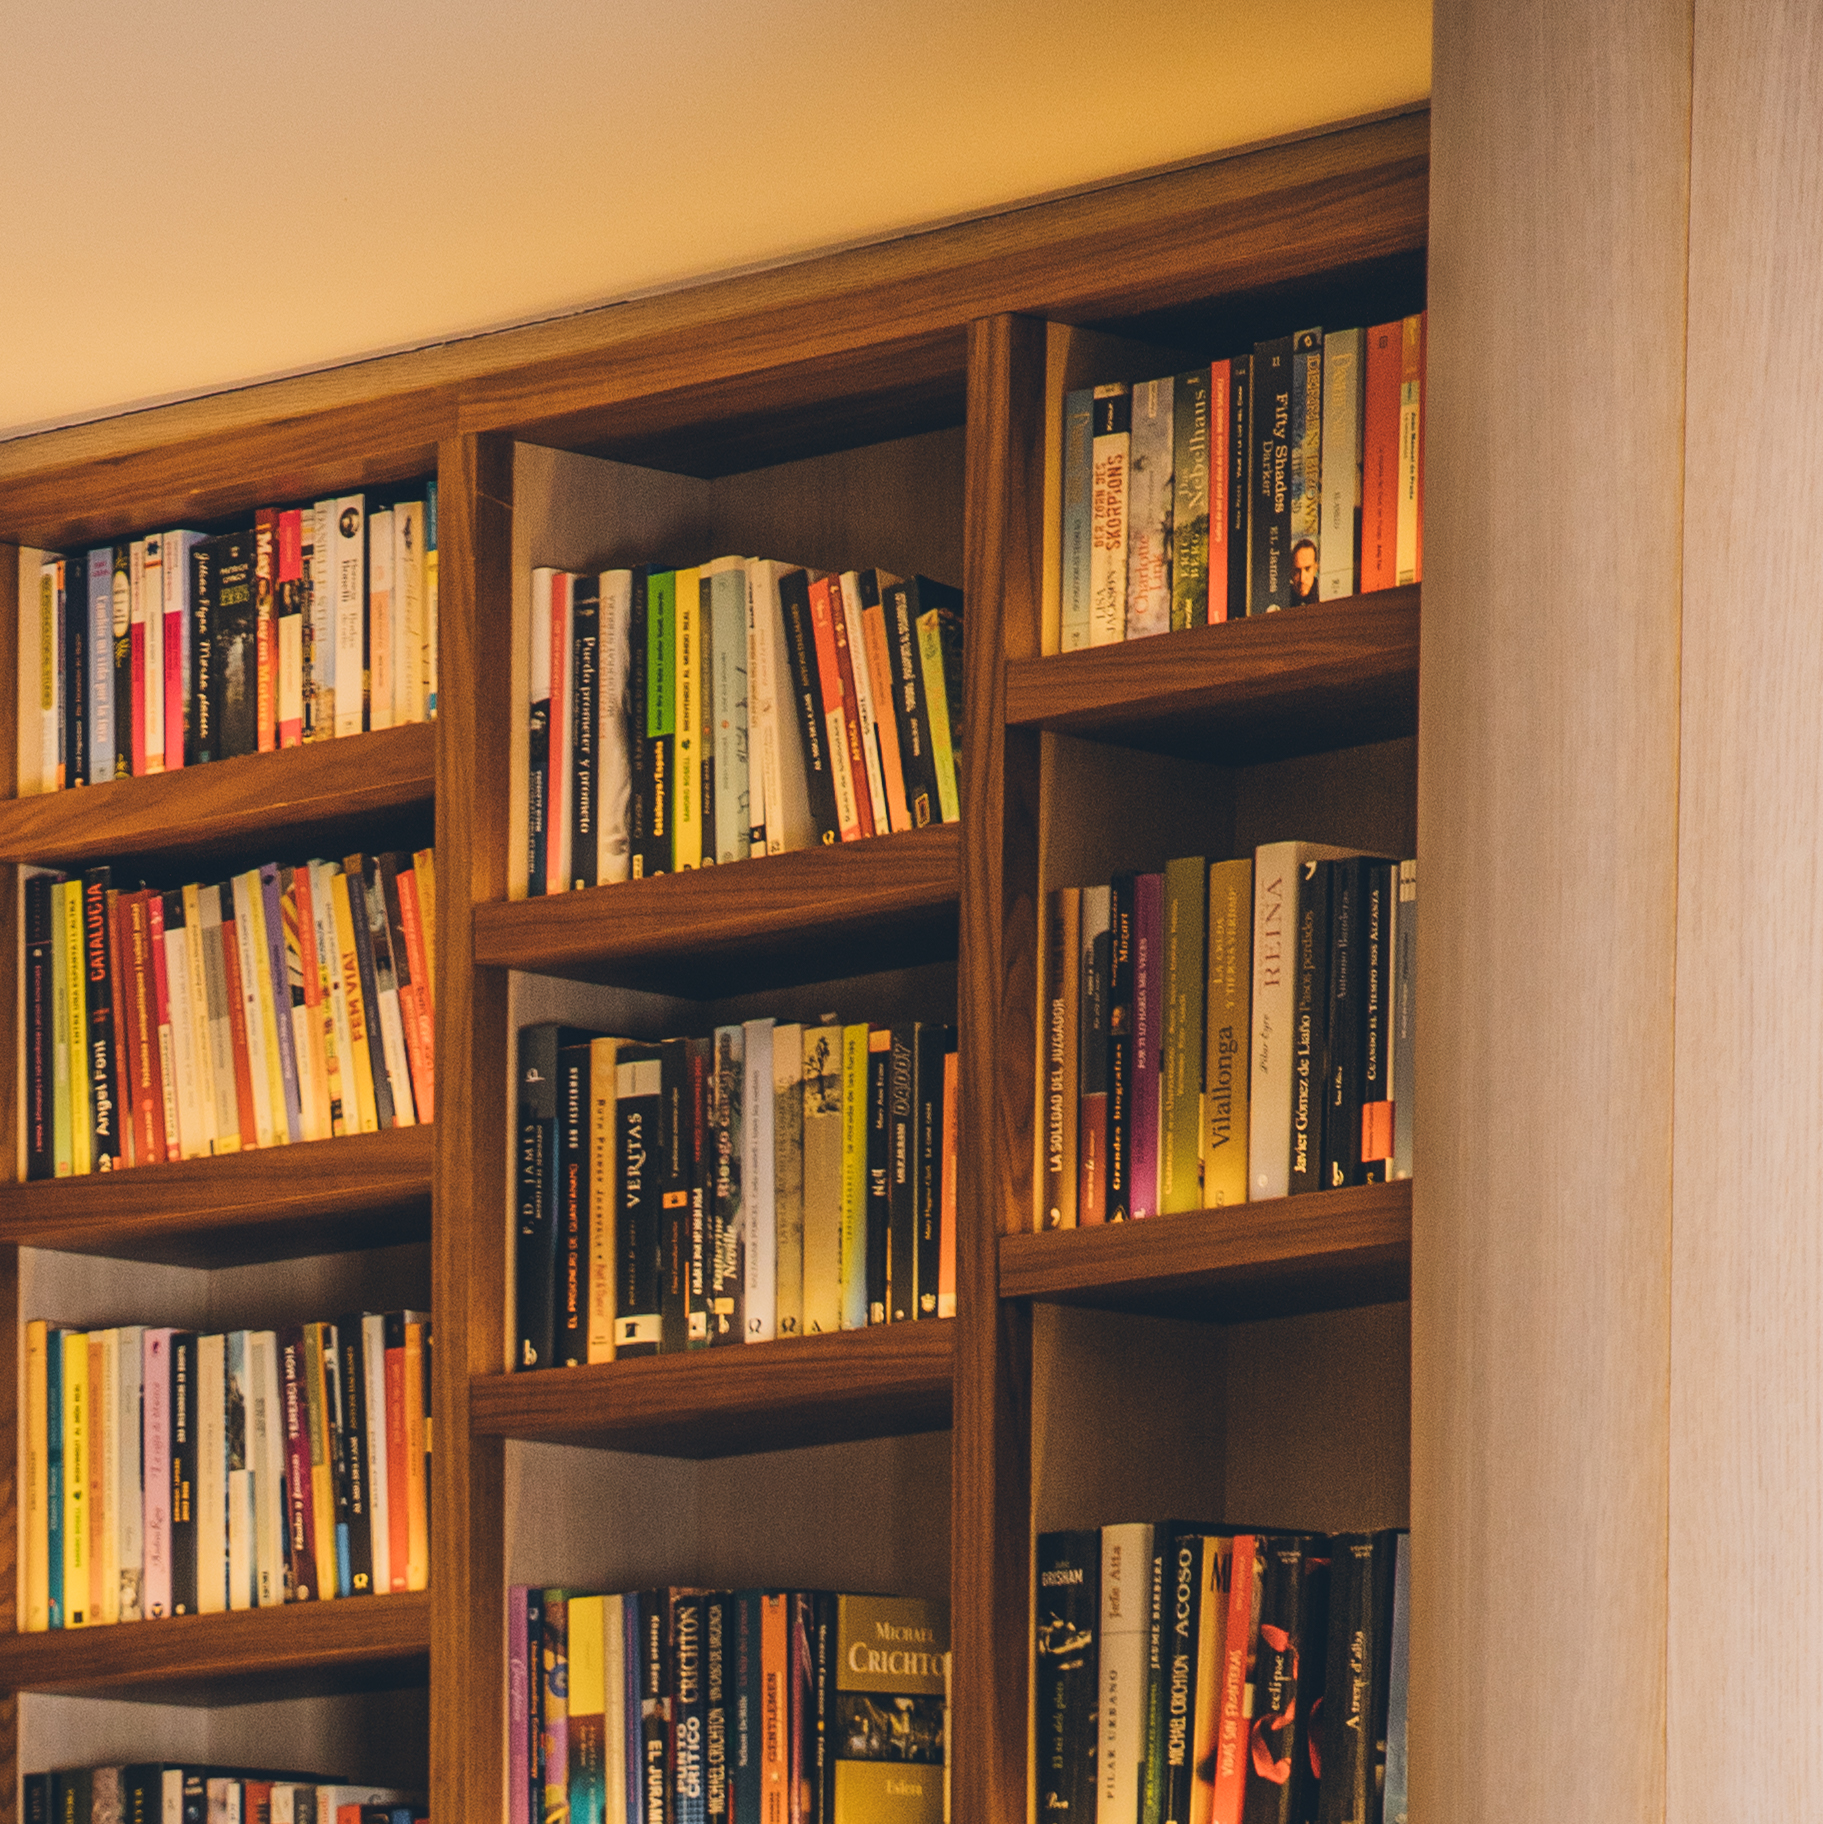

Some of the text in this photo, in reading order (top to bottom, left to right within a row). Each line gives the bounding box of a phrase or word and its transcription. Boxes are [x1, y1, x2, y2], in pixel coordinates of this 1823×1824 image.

[1189, 390, 1207, 507] Nebelhaus
[1262, 440, 1273, 496] Darker
[1273, 392, 1288, 513] Fifty Shades
[1094, 490, 1106, 519] ZORN
[1106, 454, 1123, 551] SKORPIONS
[1306, 455, 1320, 534] BROWN
[257, 532, 272, 580] May
[1094, 524, 1106, 548] DER
[1133, 535, 1149, 614] Charlotte
[1150, 555, 1163, 591] Link
[257, 604, 270, 639] May
[1096, 588, 1107, 620] LISA
[1107, 571, 1117, 631] JACKSON
[257, 665, 270, 731] Motors
[577, 637, 596, 834] Puedo prometer y prometo
[87, 883, 107, 982] CATALUCIA
[1119, 913, 1129, 962] Mozart
[1264, 878, 1283, 986] REINA
[343, 951, 365, 1042] FEM VIA!
[1299, 975, 1312, 1011] Pasos
[93, 1040, 112, 1136] Angel Font
[893, 1044, 911, 1116] DADDY
[1051, 998, 1063, 1171] LA SOLEDAD DEL JUZGADOR
[1212, 1026, 1238, 1149] Vilallonga
[1259, 1043, 1270, 1074] Pilar
[1294, 1015, 1311, 1173] Javier Gómez de Liaño
[626, 1113, 646, 1209] VERITAS
[724, 1225, 737, 1278] Neville
[287, 1382, 300, 1440] TERENCI
[875, 1621, 934, 1643] MICHAEL
[1109, 1588, 1123, 1619] Jefe
[1175, 1548, 1193, 1637] ACOSO
[678, 1606, 699, 1703] CRICHTON
[1269, 1655, 1292, 1710] eclipse
[766, 1672, 777, 1762] GENTLEMEN
[1106, 1670, 1118, 1799] PILAR URBANO
[1168, 1655, 1189, 1765] MICHAEL CRICHTON
[1222, 1650, 1242, 1776] VIDAS SIN FRONTERAS
[648, 1740, 664, 1762] EL
[676, 1723, 688, 1793] PUNTO
[707, 1707, 725, 1814] MICHAEL CRICHTON
